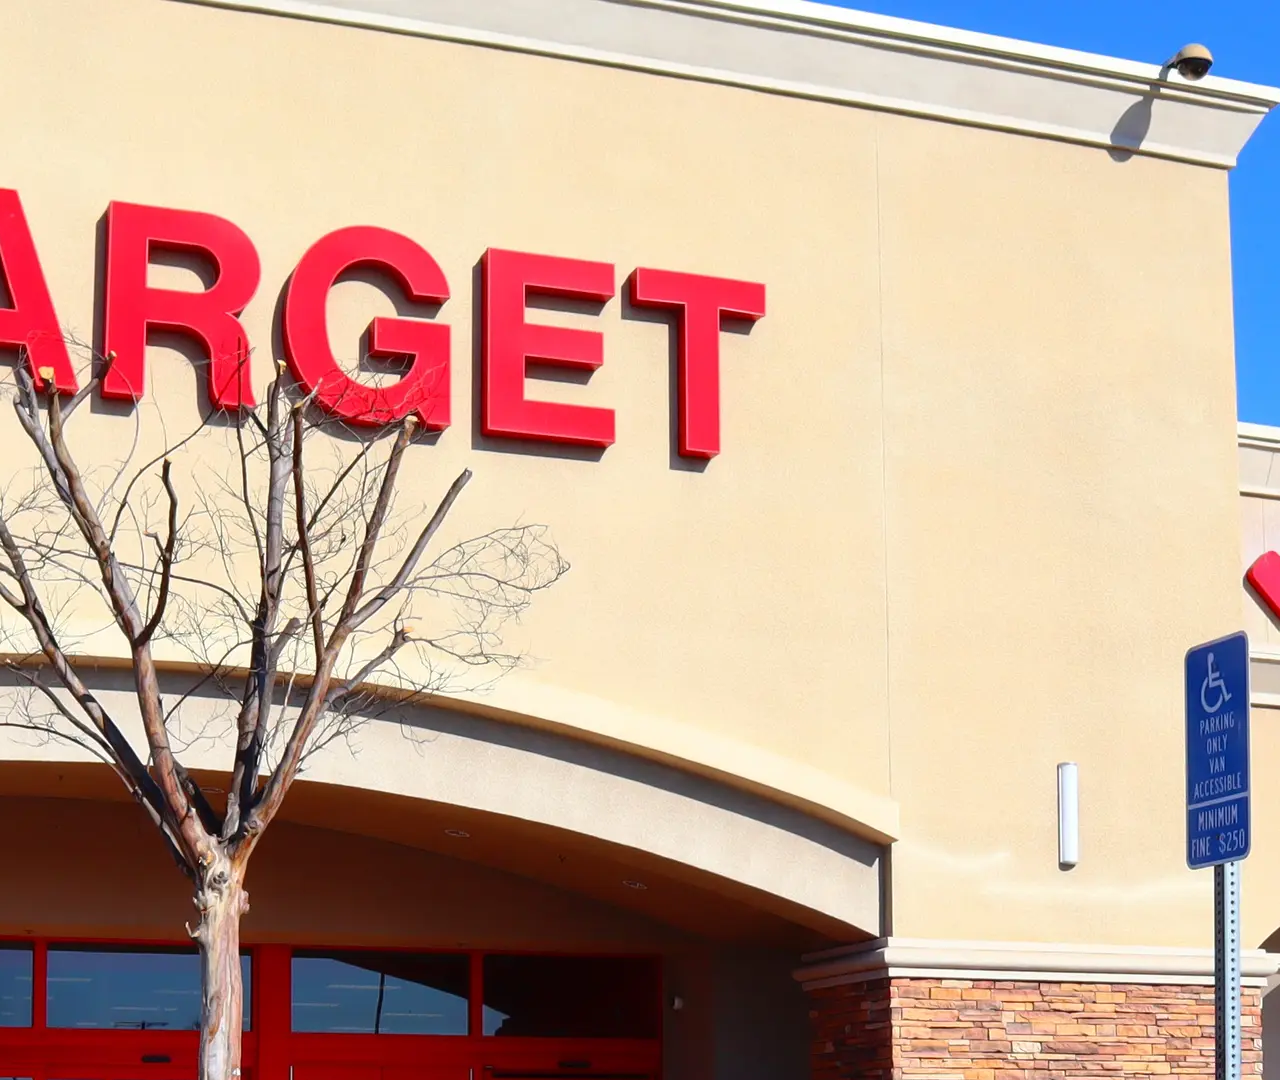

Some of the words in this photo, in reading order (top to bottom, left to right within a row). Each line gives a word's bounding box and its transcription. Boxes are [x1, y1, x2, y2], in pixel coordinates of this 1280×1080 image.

[1200, 711, 1235, 736] PARKING
[1206, 734, 1228, 754] ONLY
[1209, 756, 1225, 774] VAN
[1194, 772, 1242, 800] ACCESSIBLE
[1198, 803, 1238, 831] MINIMUM
[1191, 836, 1211, 859] FINE
[1219, 828, 1245, 855] $250
